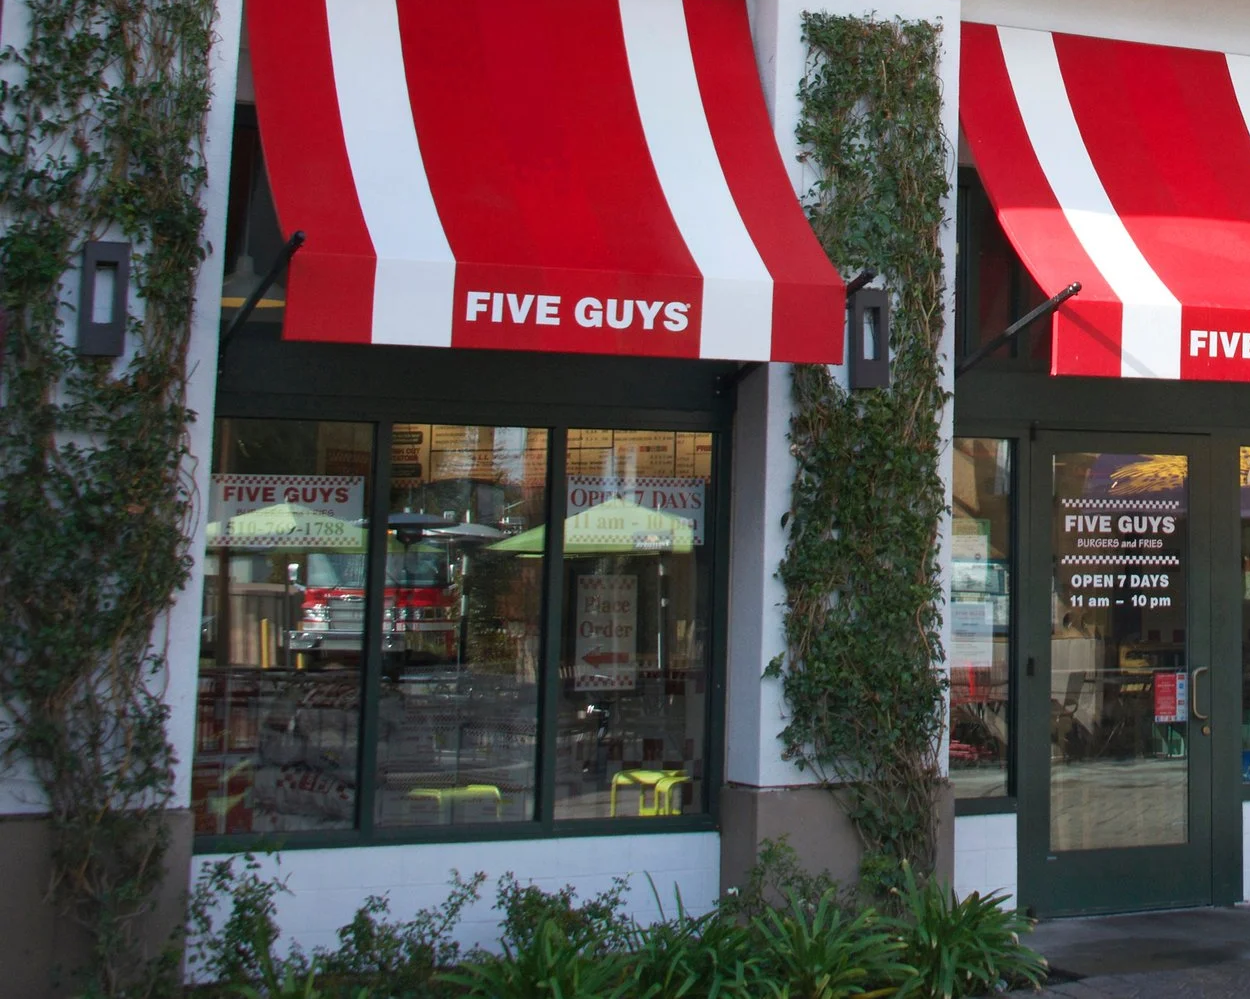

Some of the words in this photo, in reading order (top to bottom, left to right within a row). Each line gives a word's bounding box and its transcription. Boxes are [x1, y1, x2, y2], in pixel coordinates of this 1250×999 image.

[465, 291, 561, 326] FIVE
[574, 296, 690, 332] GUYS
[223, 486, 276, 502] FIVE
[284, 487, 349, 503] GUYS
[634, 489, 645, 508] 7
[652, 490, 702, 509] DAYS
[573, 513, 590, 530] 11
[596, 516, 625, 530] am
[1065, 515, 1112, 533] FIVE
[1118, 515, 1176, 534] GUYS
[1077, 538, 1120, 548] BURGERS
[1121, 539, 1137, 548] and
[1138, 538, 1163, 548] FRIES
[1071, 574, 1114, 588] OPEN
[1117, 574, 1127, 588] 7
[1130, 574, 1169, 588] DAYS
[1070, 594, 1084, 607] 11
[1088, 596, 1110, 607] am
[1131, 594, 1147, 607] 10
[1150, 597, 1171, 609] pm
[580, 620, 633, 638] Order
